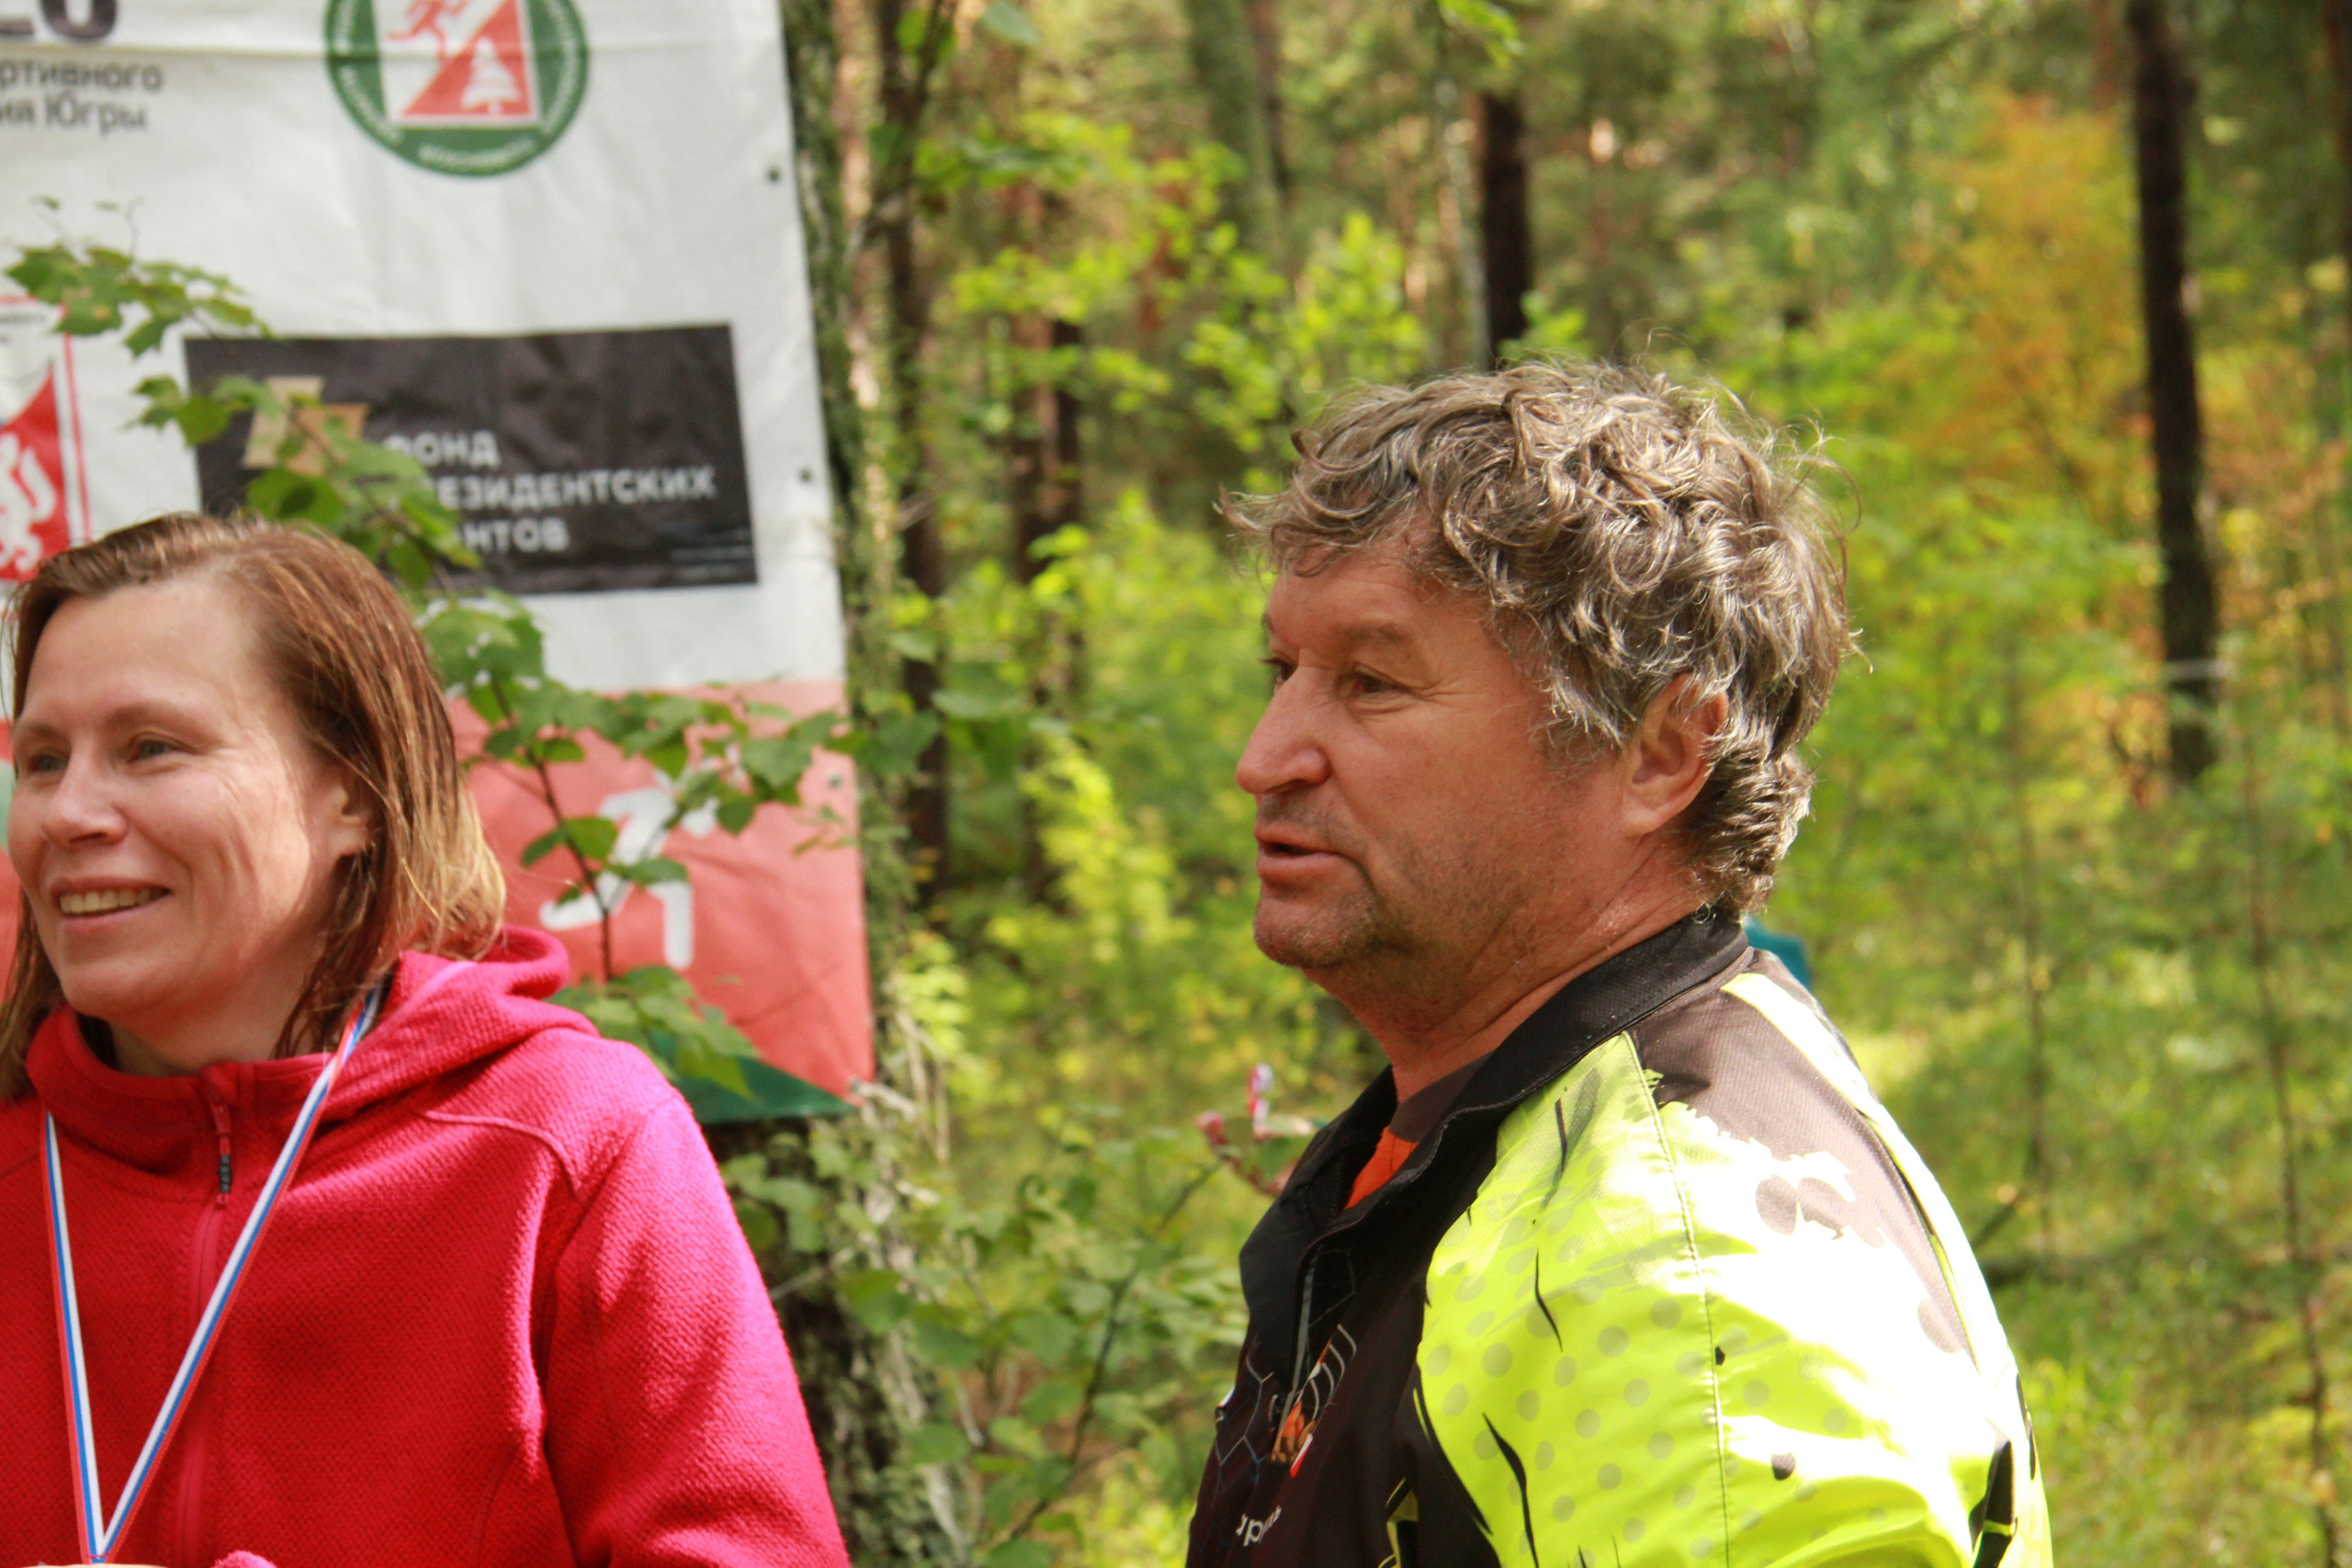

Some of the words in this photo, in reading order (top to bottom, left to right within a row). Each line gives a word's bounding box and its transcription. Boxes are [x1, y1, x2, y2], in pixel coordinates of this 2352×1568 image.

[45, 92, 146, 138] Югры
[416, 463, 718, 513] ЕЗИДЕНТСКИХ
[461, 516, 571, 554] НТОВ
